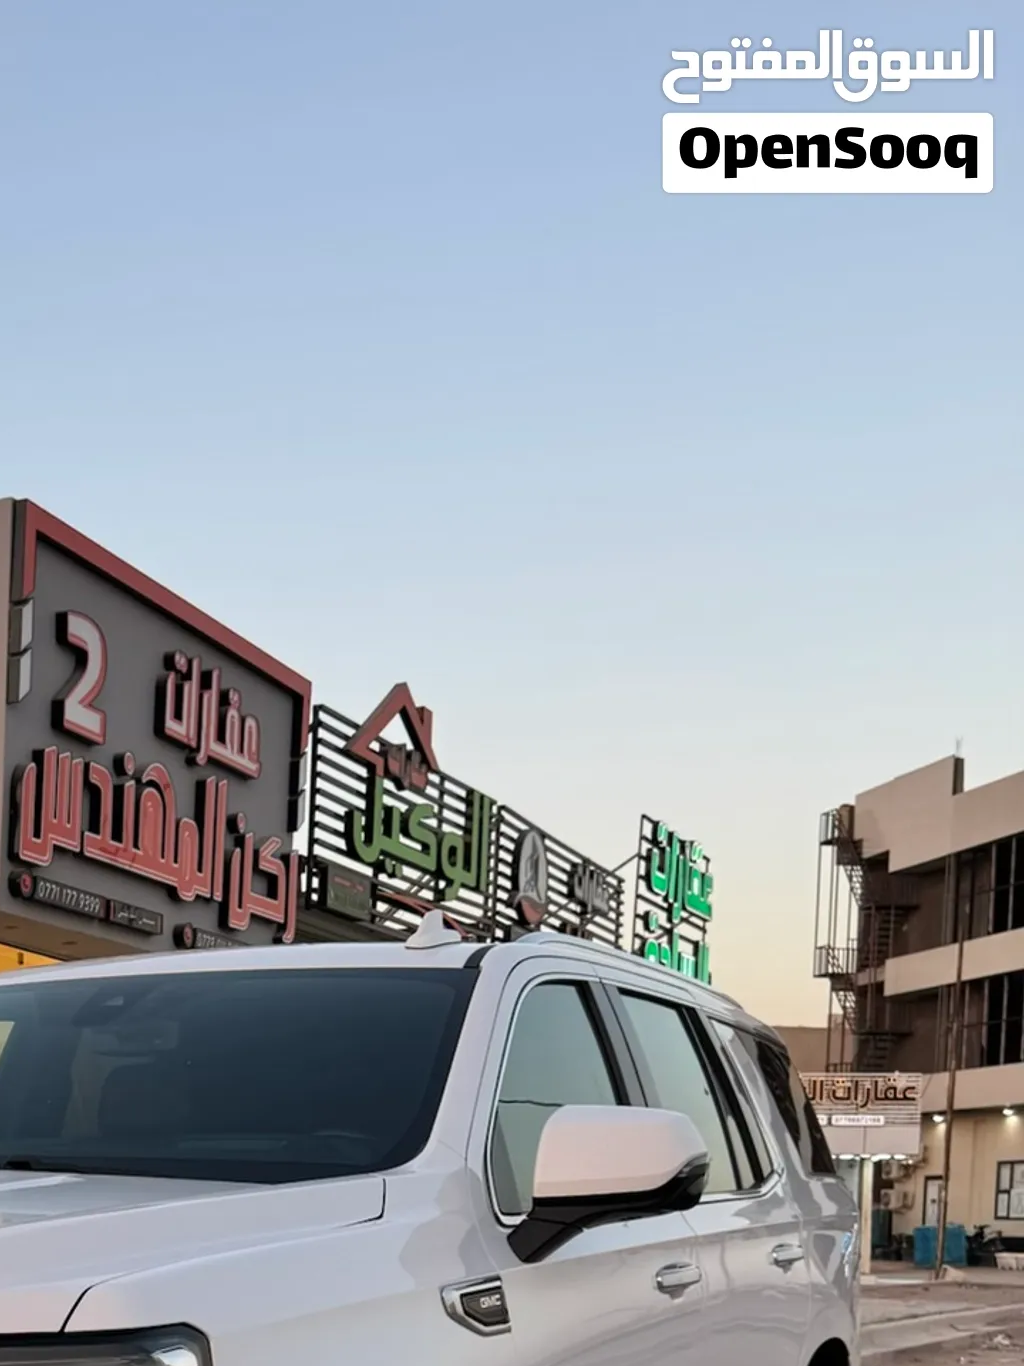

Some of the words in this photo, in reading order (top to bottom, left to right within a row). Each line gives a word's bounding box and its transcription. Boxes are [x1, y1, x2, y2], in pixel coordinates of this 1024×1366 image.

[56, 609, 107, 745] 2
[160, 651, 262, 780] عقارات
[18, 745, 228, 902] المهندس
[227, 812, 300, 944] ركن
[351, 776, 493, 902] الوكيل
[650, 820, 714, 923] عقارات
[831, 1077, 917, 1109] عقارات
[479, 1294, 502, 1309] GMC
